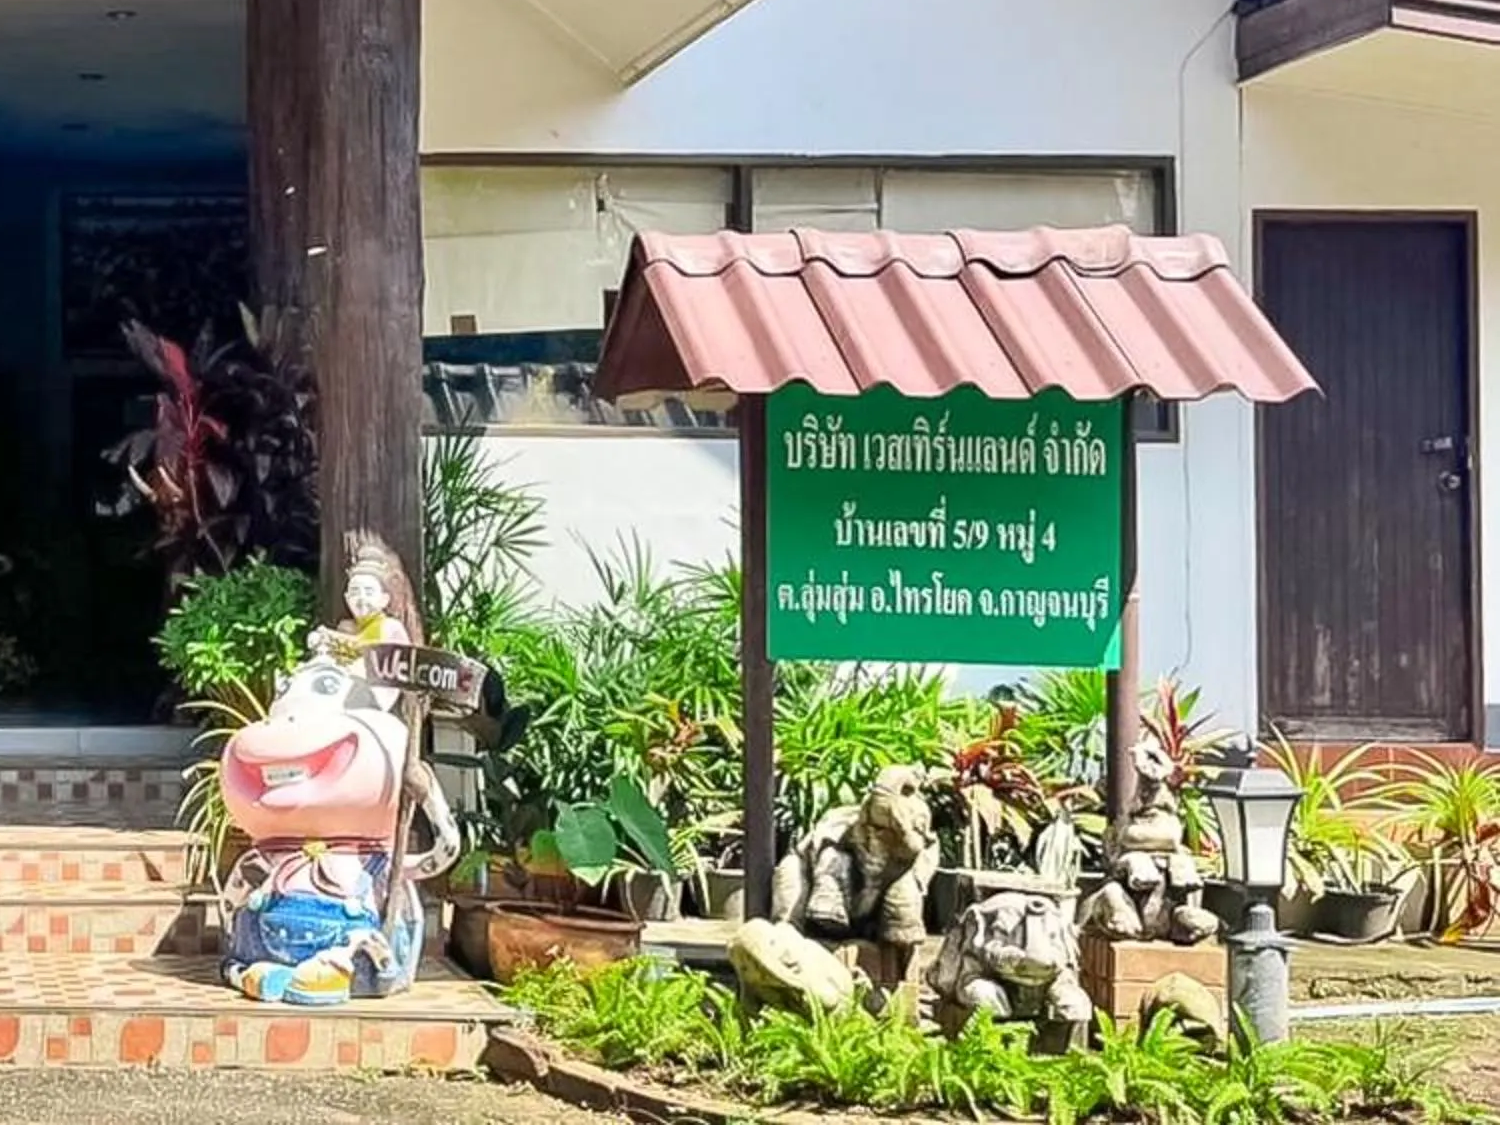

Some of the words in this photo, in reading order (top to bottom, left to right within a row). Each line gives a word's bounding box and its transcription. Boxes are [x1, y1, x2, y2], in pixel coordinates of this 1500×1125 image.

[784, 413, 857, 470] บริษัท
[863, 410, 1037, 474] เวสเทิร์นแลนด์
[1043, 419, 1106, 475] จำกัด
[834, 496, 947, 548] บ้านเลขที่
[953, 519, 989, 551] 5/9
[996, 508, 1038, 564] หมู่
[1041, 521, 1057, 552] 4
[777, 569, 864, 626] ต.ลุ่มสุ่ม
[871, 569, 973, 616] อ.ไทรโยค
[978, 575, 1110, 632] จ.กาญจนบุรี
